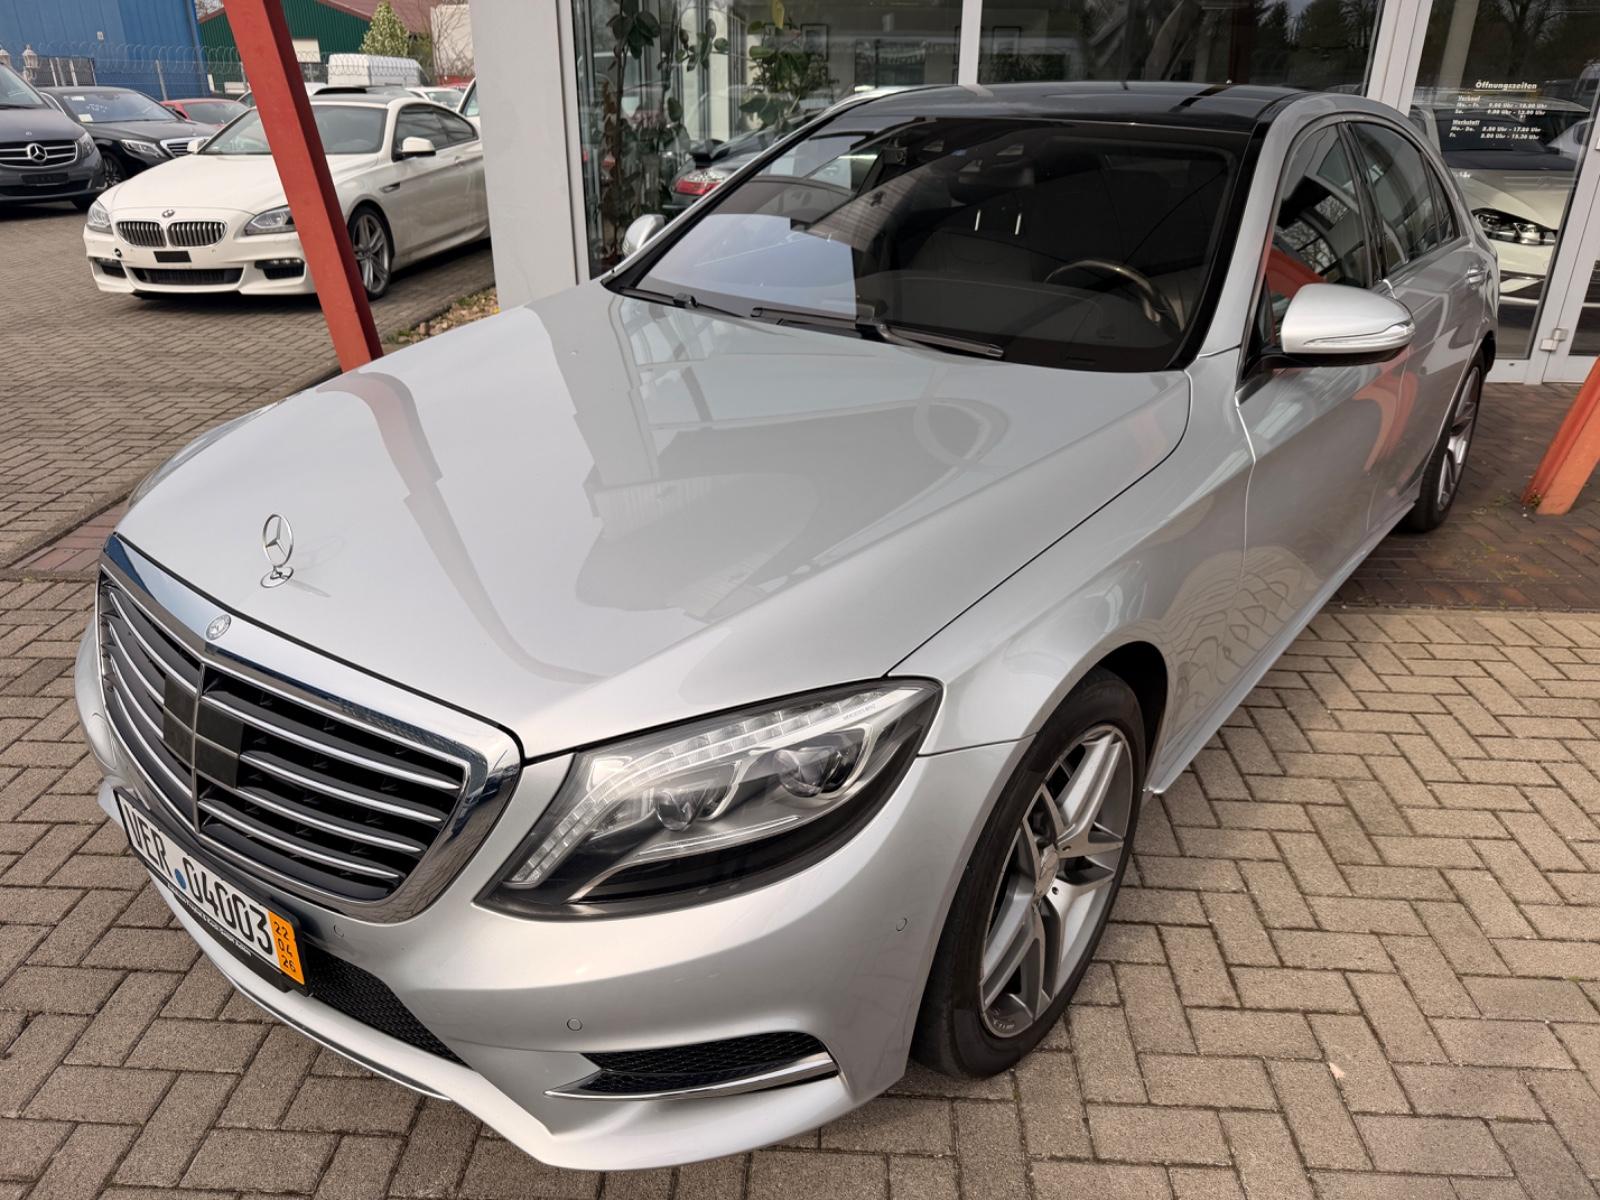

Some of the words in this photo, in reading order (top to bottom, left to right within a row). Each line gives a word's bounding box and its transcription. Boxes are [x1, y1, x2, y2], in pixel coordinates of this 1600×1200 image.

[1475, 80, 1538, 91] Öffnungszeiten
[124, 803, 173, 879] VER
[182, 856, 273, 956] 04003
[273, 920, 289, 941] 22
[277, 938, 293, 958] 04
